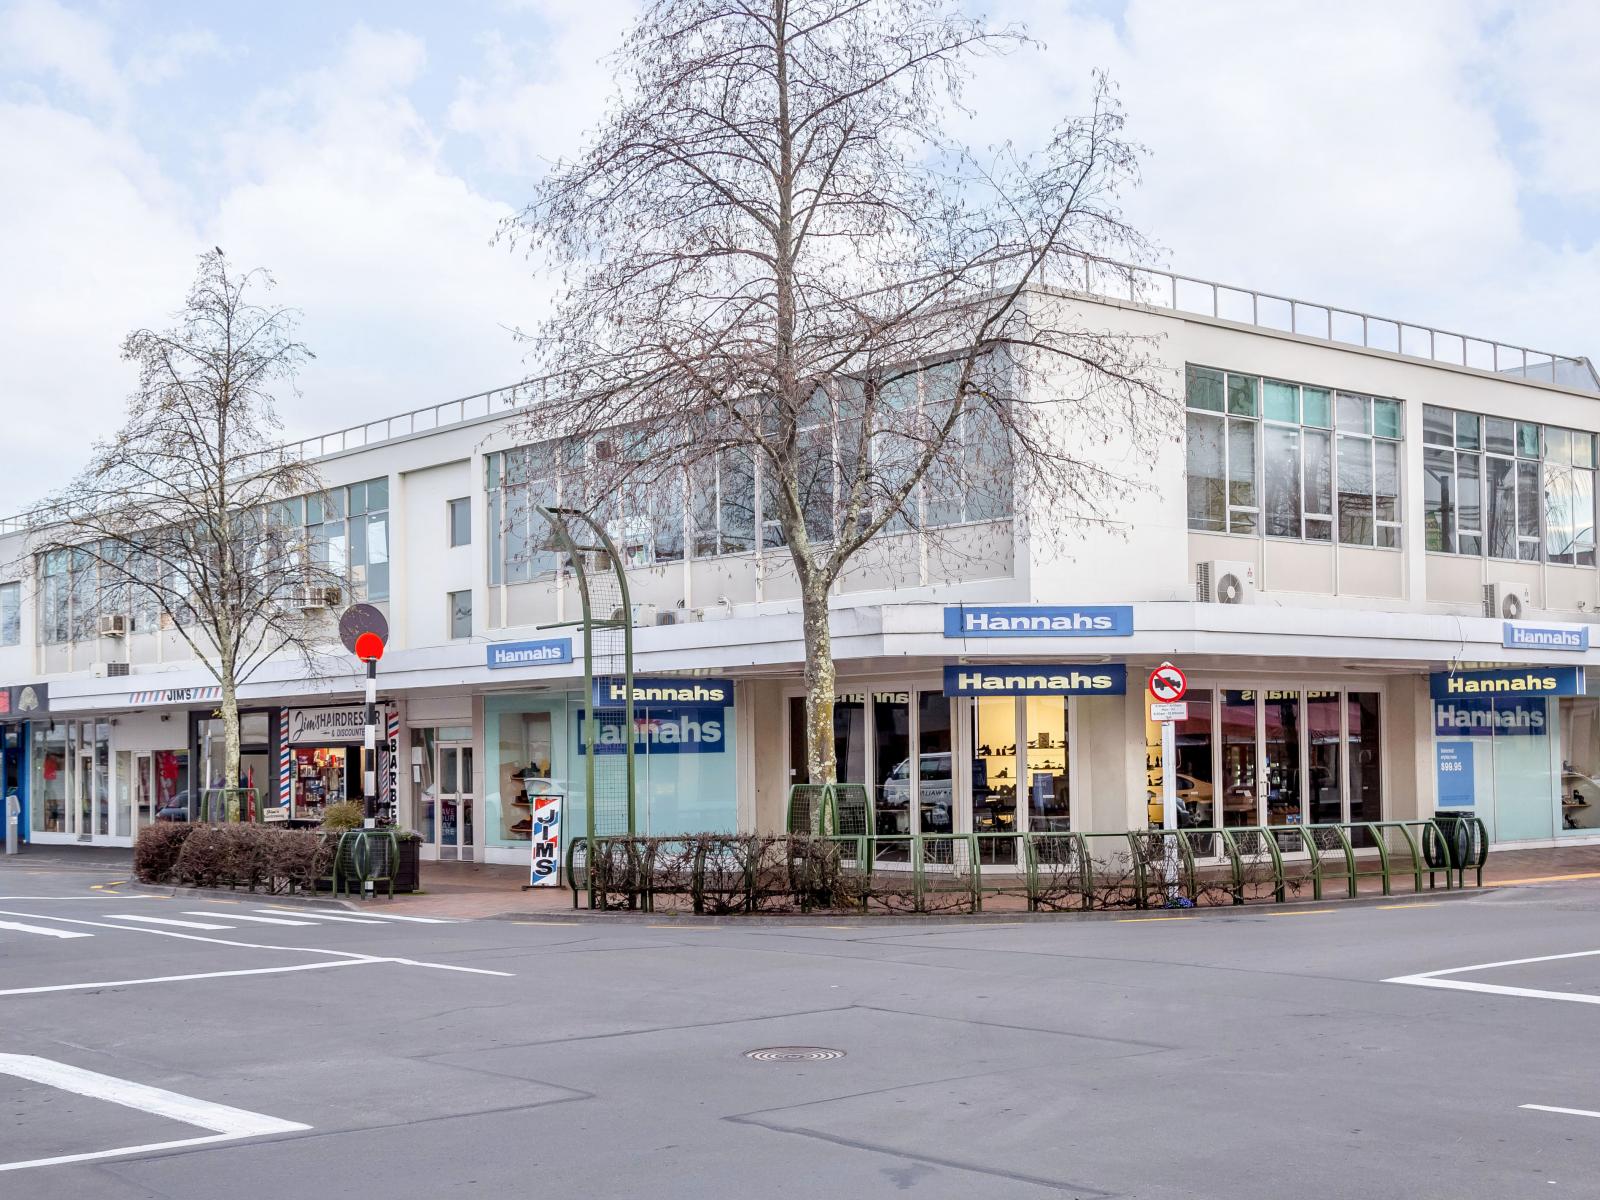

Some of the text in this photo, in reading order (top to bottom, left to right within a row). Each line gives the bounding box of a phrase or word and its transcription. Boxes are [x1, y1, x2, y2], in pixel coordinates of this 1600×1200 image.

[965, 612, 1113, 630] Hannahs
[1513, 629, 1581, 646] Hannahs
[495, 645, 561, 663] Hannahs
[958, 672, 1113, 690] Hannahs
[1447, 675, 1557, 694] Hannahs
[166, 689, 192, 701] JIM'S
[610, 685, 725, 701] Hannahs
[1437, 704, 1544, 728] Hannahs
[293, 711, 380, 742] Jim's HAIRDRESR
[336, 728, 365, 737] DISCOUNTE
[580, 715, 722, 745] Hannahs
[1440, 761, 1462, 772] $99.95
[390, 738, 398, 819] BARBE
[535, 809, 556, 876] JIMS
